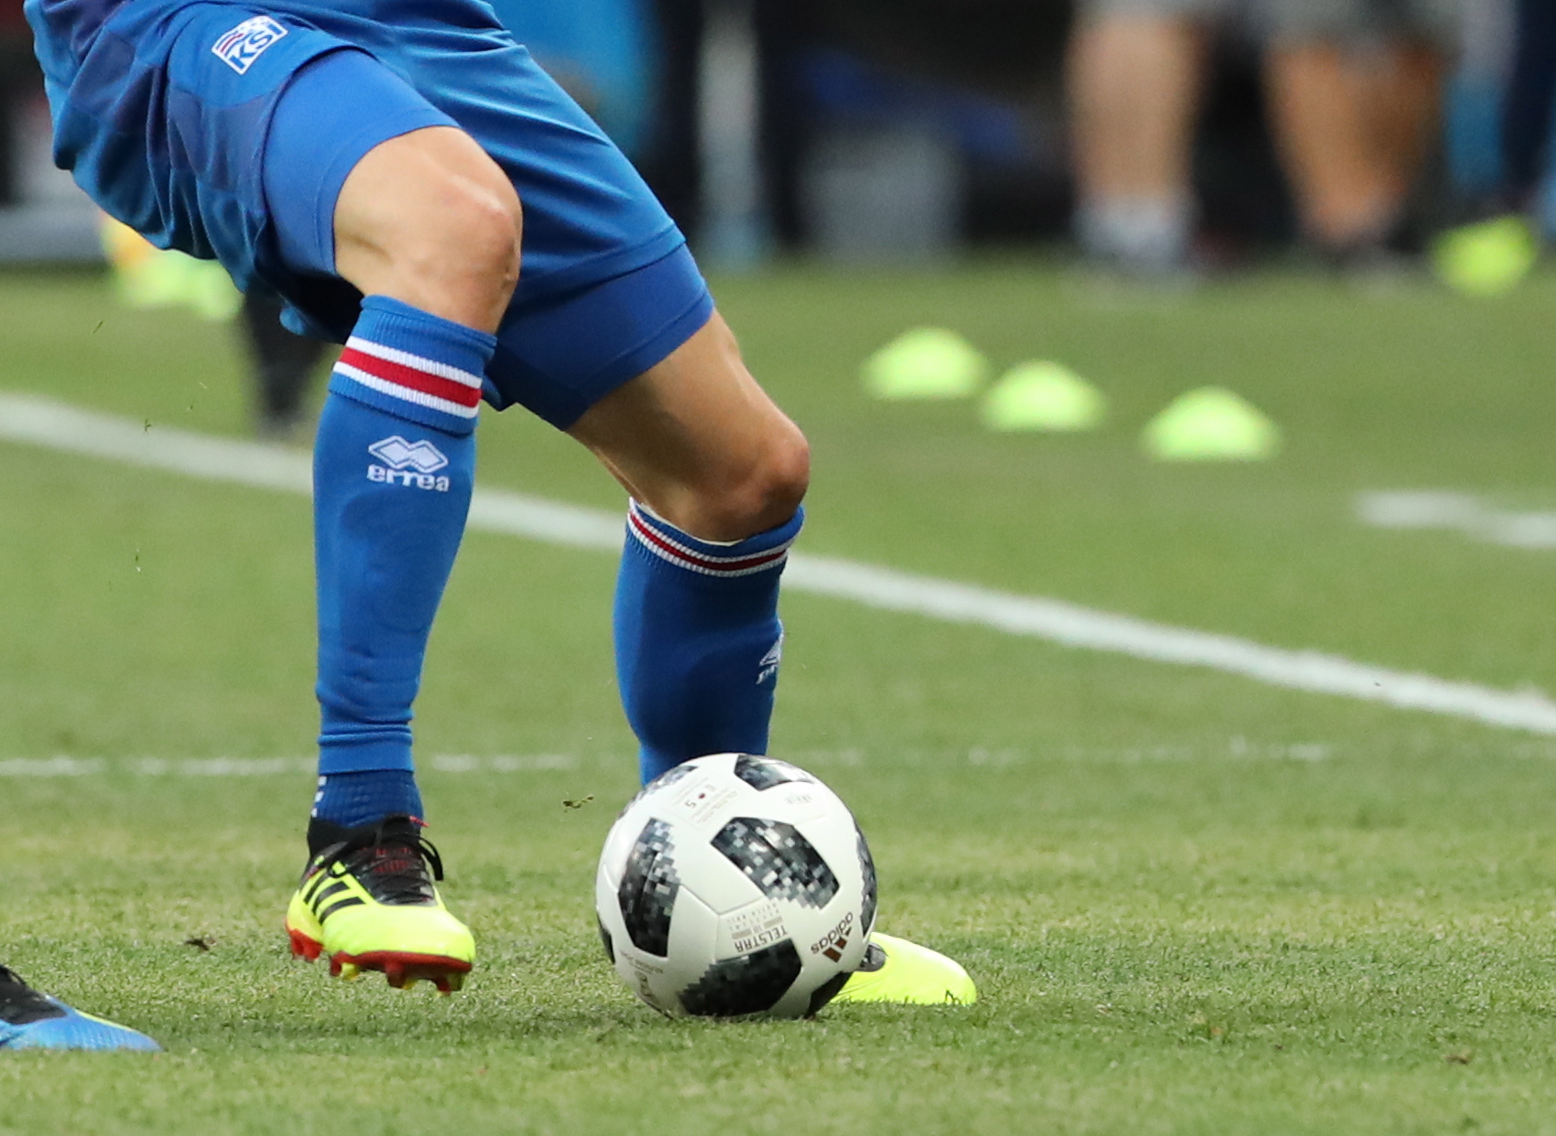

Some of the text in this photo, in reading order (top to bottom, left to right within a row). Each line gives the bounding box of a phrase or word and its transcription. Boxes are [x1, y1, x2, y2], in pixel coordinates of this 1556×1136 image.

[367, 464, 450, 492] errea
[734, 925, 788, 953] TELSTAR
[811, 912, 854, 954] adidas
